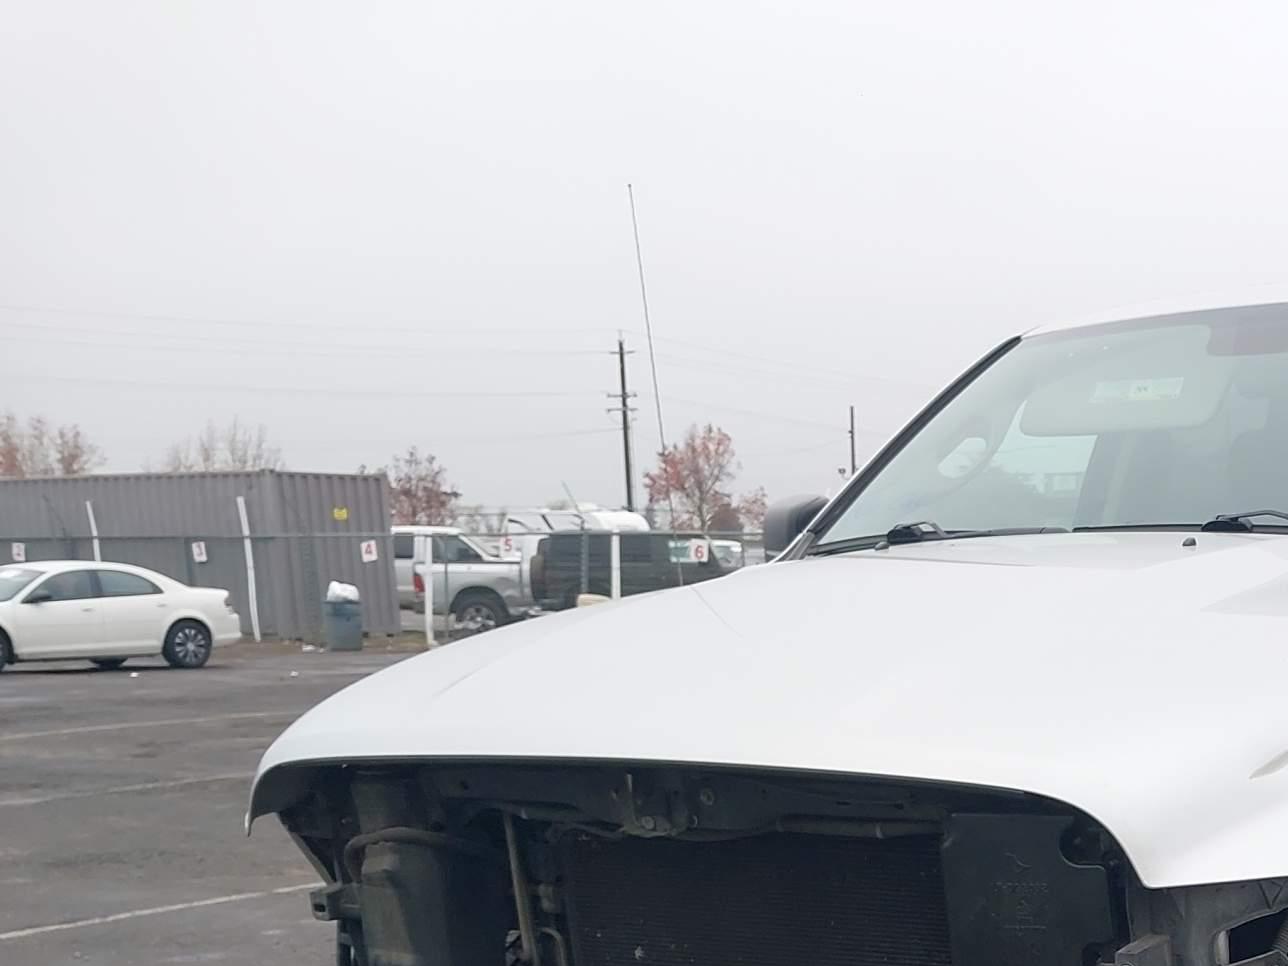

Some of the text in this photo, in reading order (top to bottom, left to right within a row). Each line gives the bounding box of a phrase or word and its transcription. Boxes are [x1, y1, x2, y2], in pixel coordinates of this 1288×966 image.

[364, 543, 373, 555] 4
[504, 538, 513, 552] 5
[695, 545, 705, 559] 6
